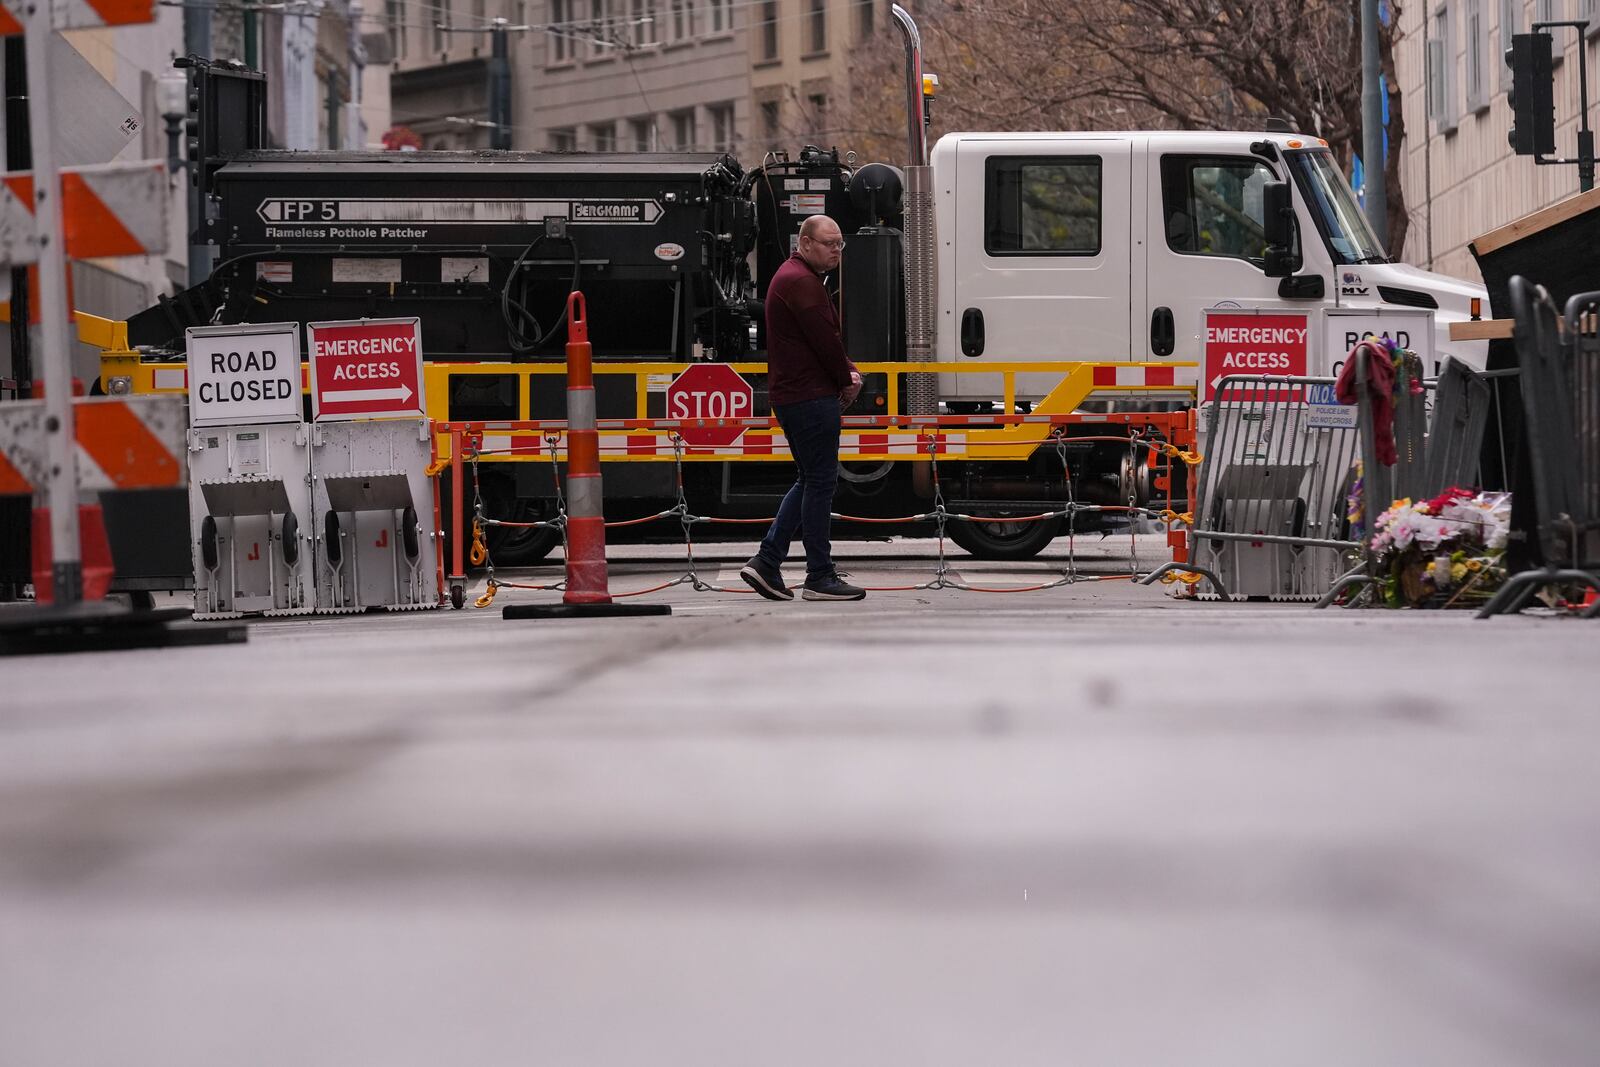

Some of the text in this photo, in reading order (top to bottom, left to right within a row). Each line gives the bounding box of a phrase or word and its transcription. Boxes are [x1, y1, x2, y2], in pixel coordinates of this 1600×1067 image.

[284, 202, 336, 220] FP 5
[572, 202, 640, 217] BERGKAMP
[265, 227, 428, 238] Flameless Pothole Patcher
[1206, 328, 1308, 344] EMERGENCY
[1345, 331, 1410, 352] RD
[314, 337, 416, 357] EMERGENCY
[211, 350, 277, 373] ROAD
[1222, 352, 1291, 368] ACCESS
[333, 362, 401, 380] ACCESS
[199, 378, 292, 404] CLOSED
[672, 391, 748, 418] STOP
[1316, 407, 1336, 415] POLICE
[1320, 416, 1332, 424] NOT
[1332, 417, 1352, 425] CROSS
